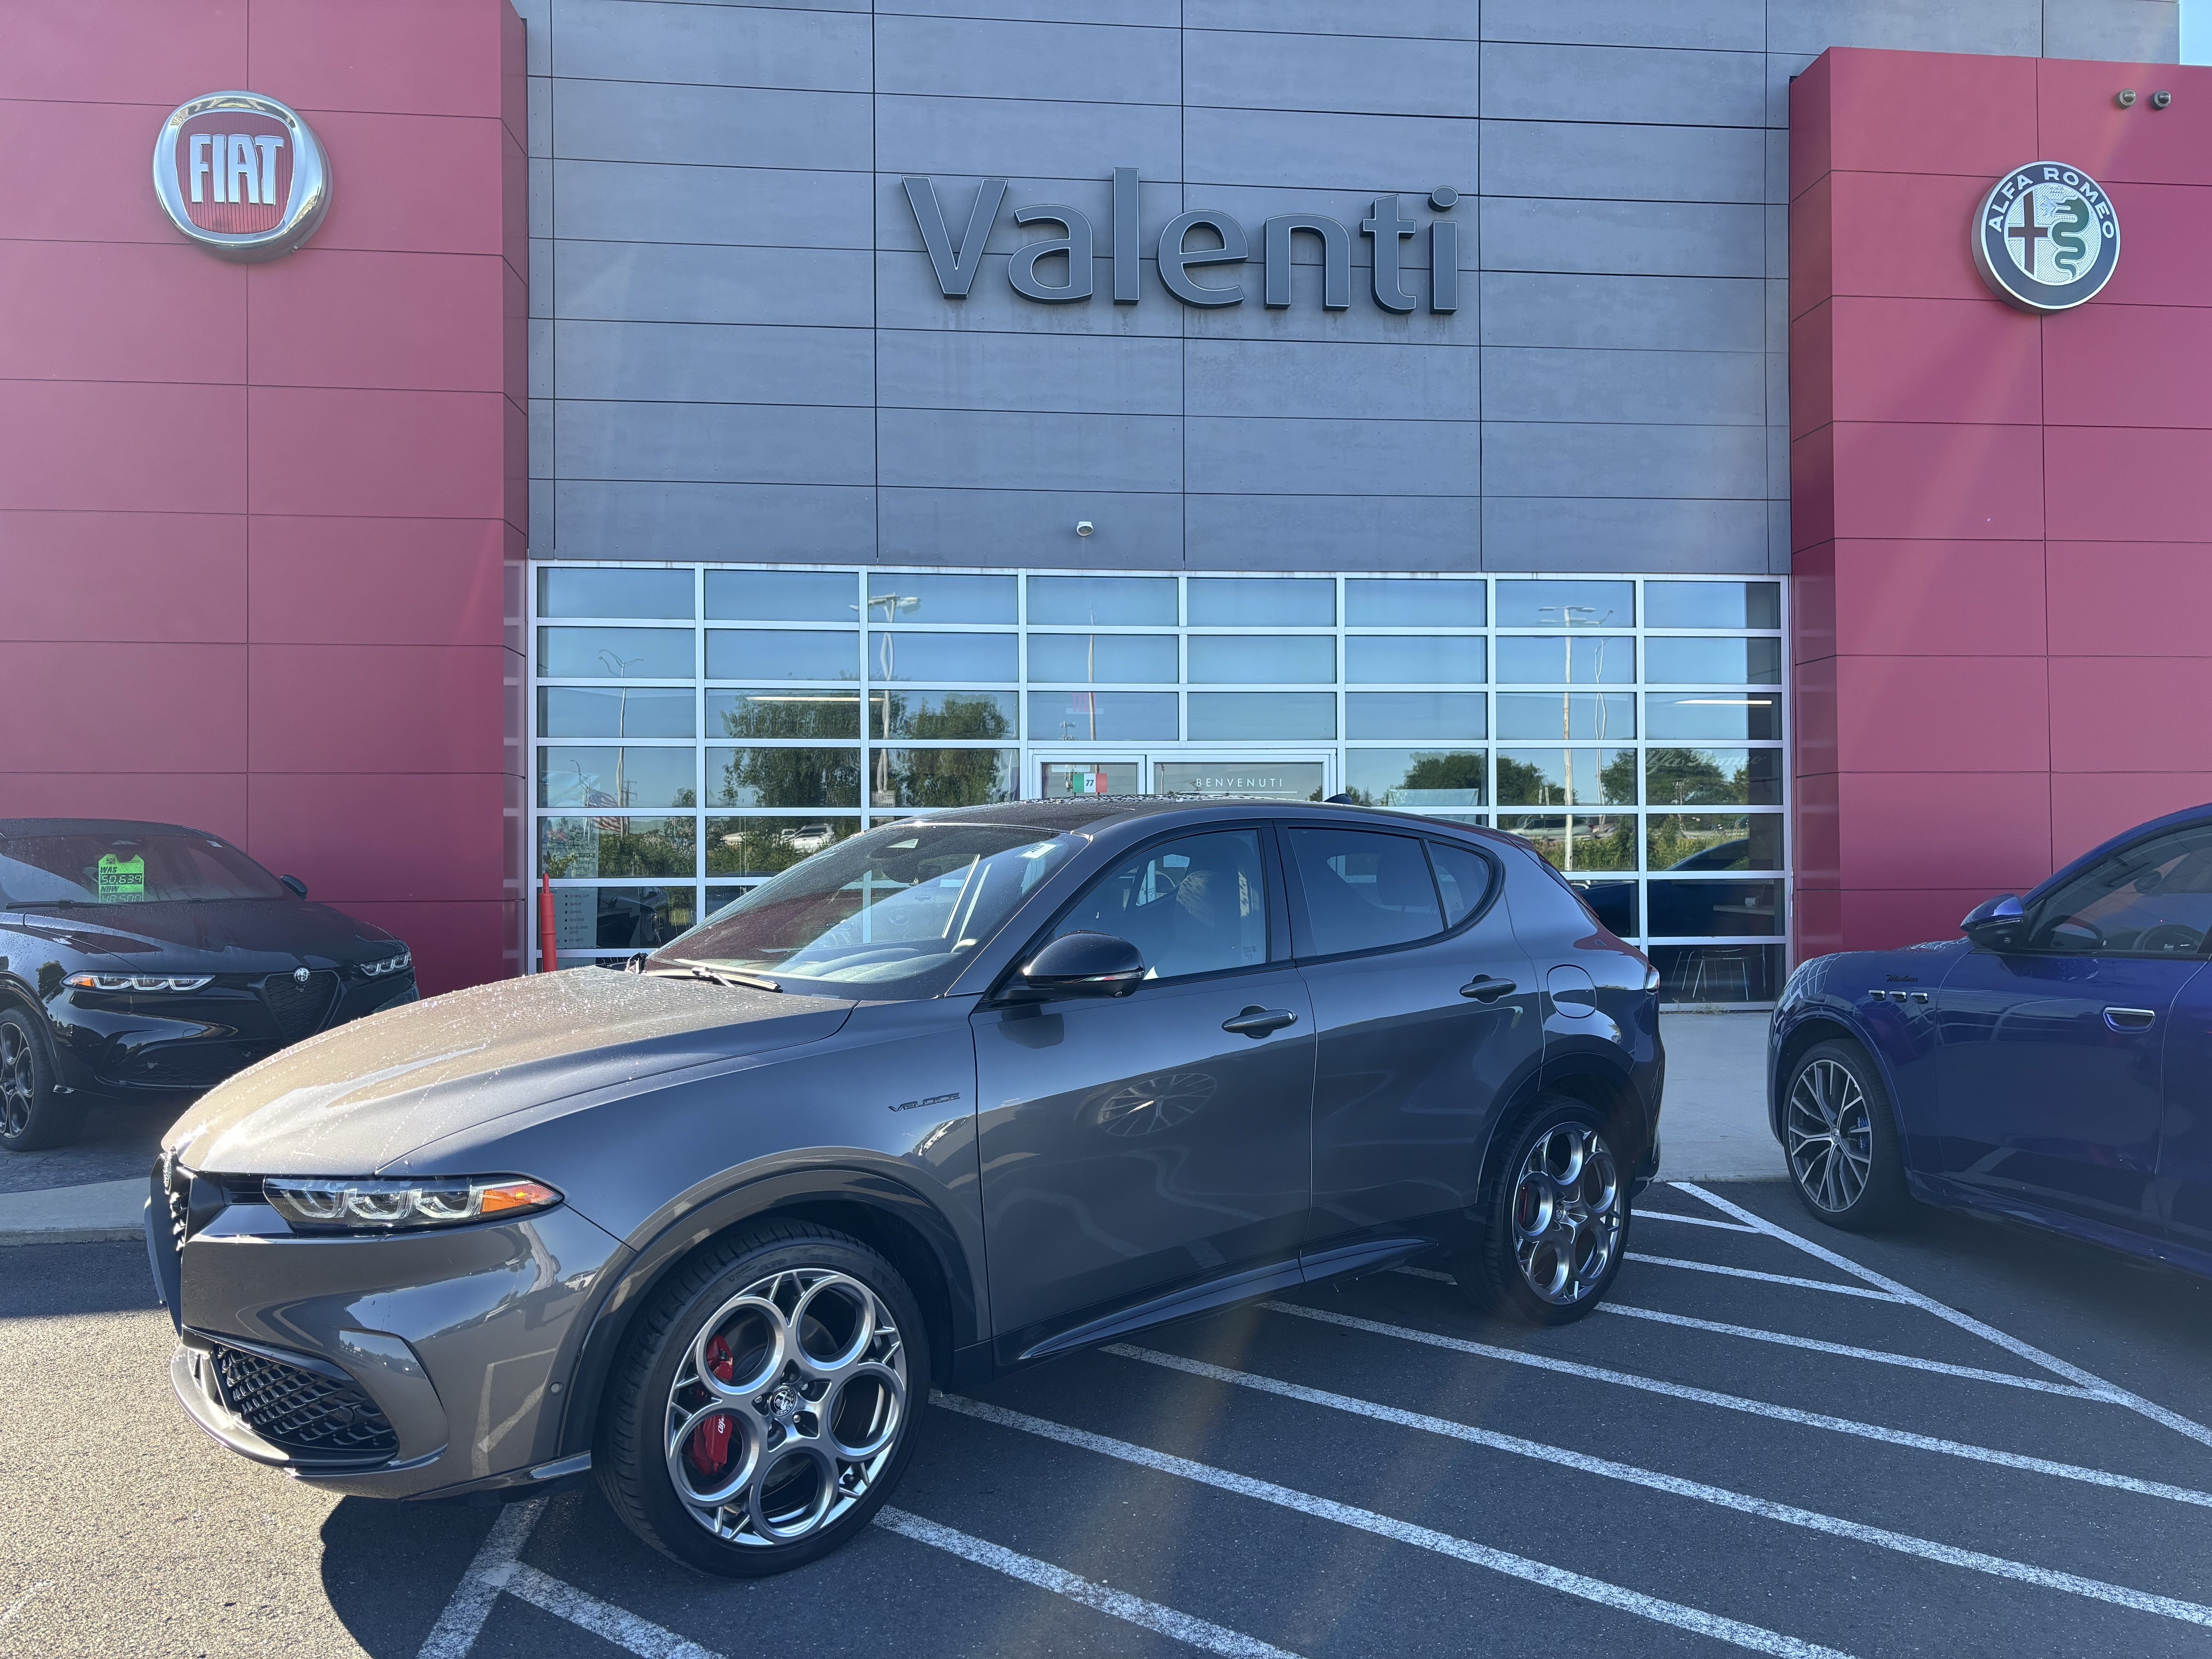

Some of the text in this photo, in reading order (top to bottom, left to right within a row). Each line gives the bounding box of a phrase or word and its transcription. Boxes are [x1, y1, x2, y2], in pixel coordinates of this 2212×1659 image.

[190, 134, 284, 205] FIAT
[1989, 167, 2114, 239] ALFA ROMEO
[901, 167, 1459, 314] Valenti
[1196, 778, 1282, 787] BENVENUTI
[888, 1092, 961, 1112] VELOCE
